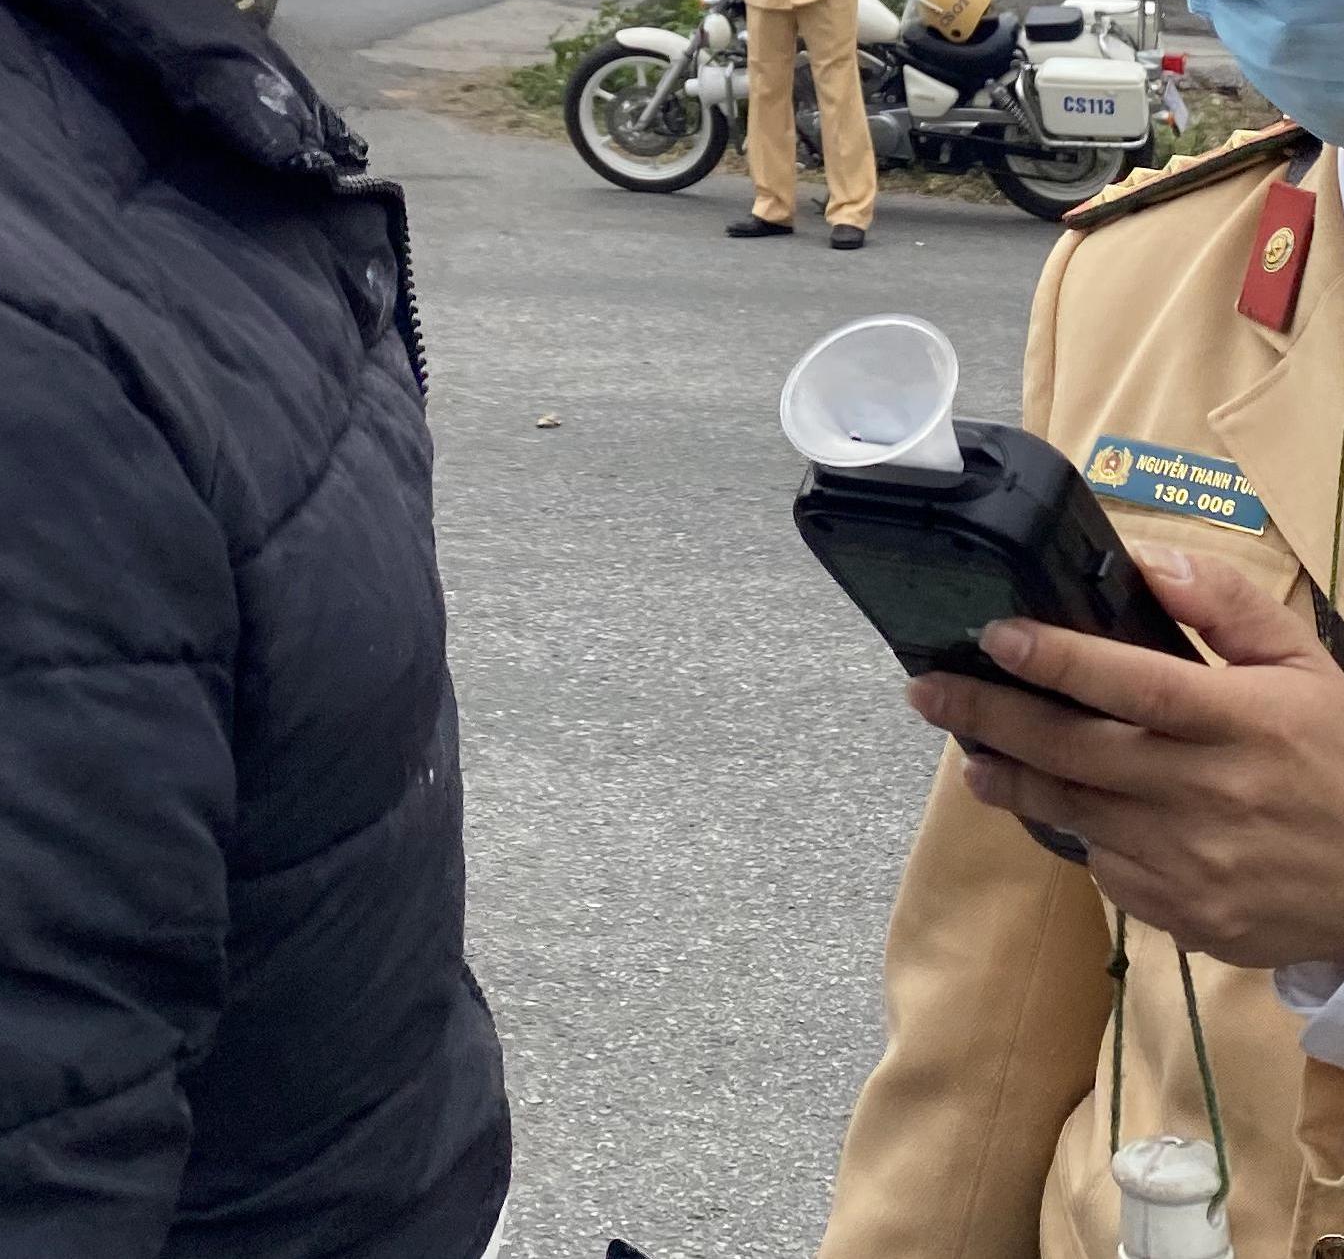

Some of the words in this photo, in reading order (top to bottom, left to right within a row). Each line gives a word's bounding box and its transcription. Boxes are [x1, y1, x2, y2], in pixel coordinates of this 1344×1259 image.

[1062, 95, 1116, 116] CS113
[1135, 454, 1187, 480] NGUYỄN
[1188, 465, 1234, 490] THANH
